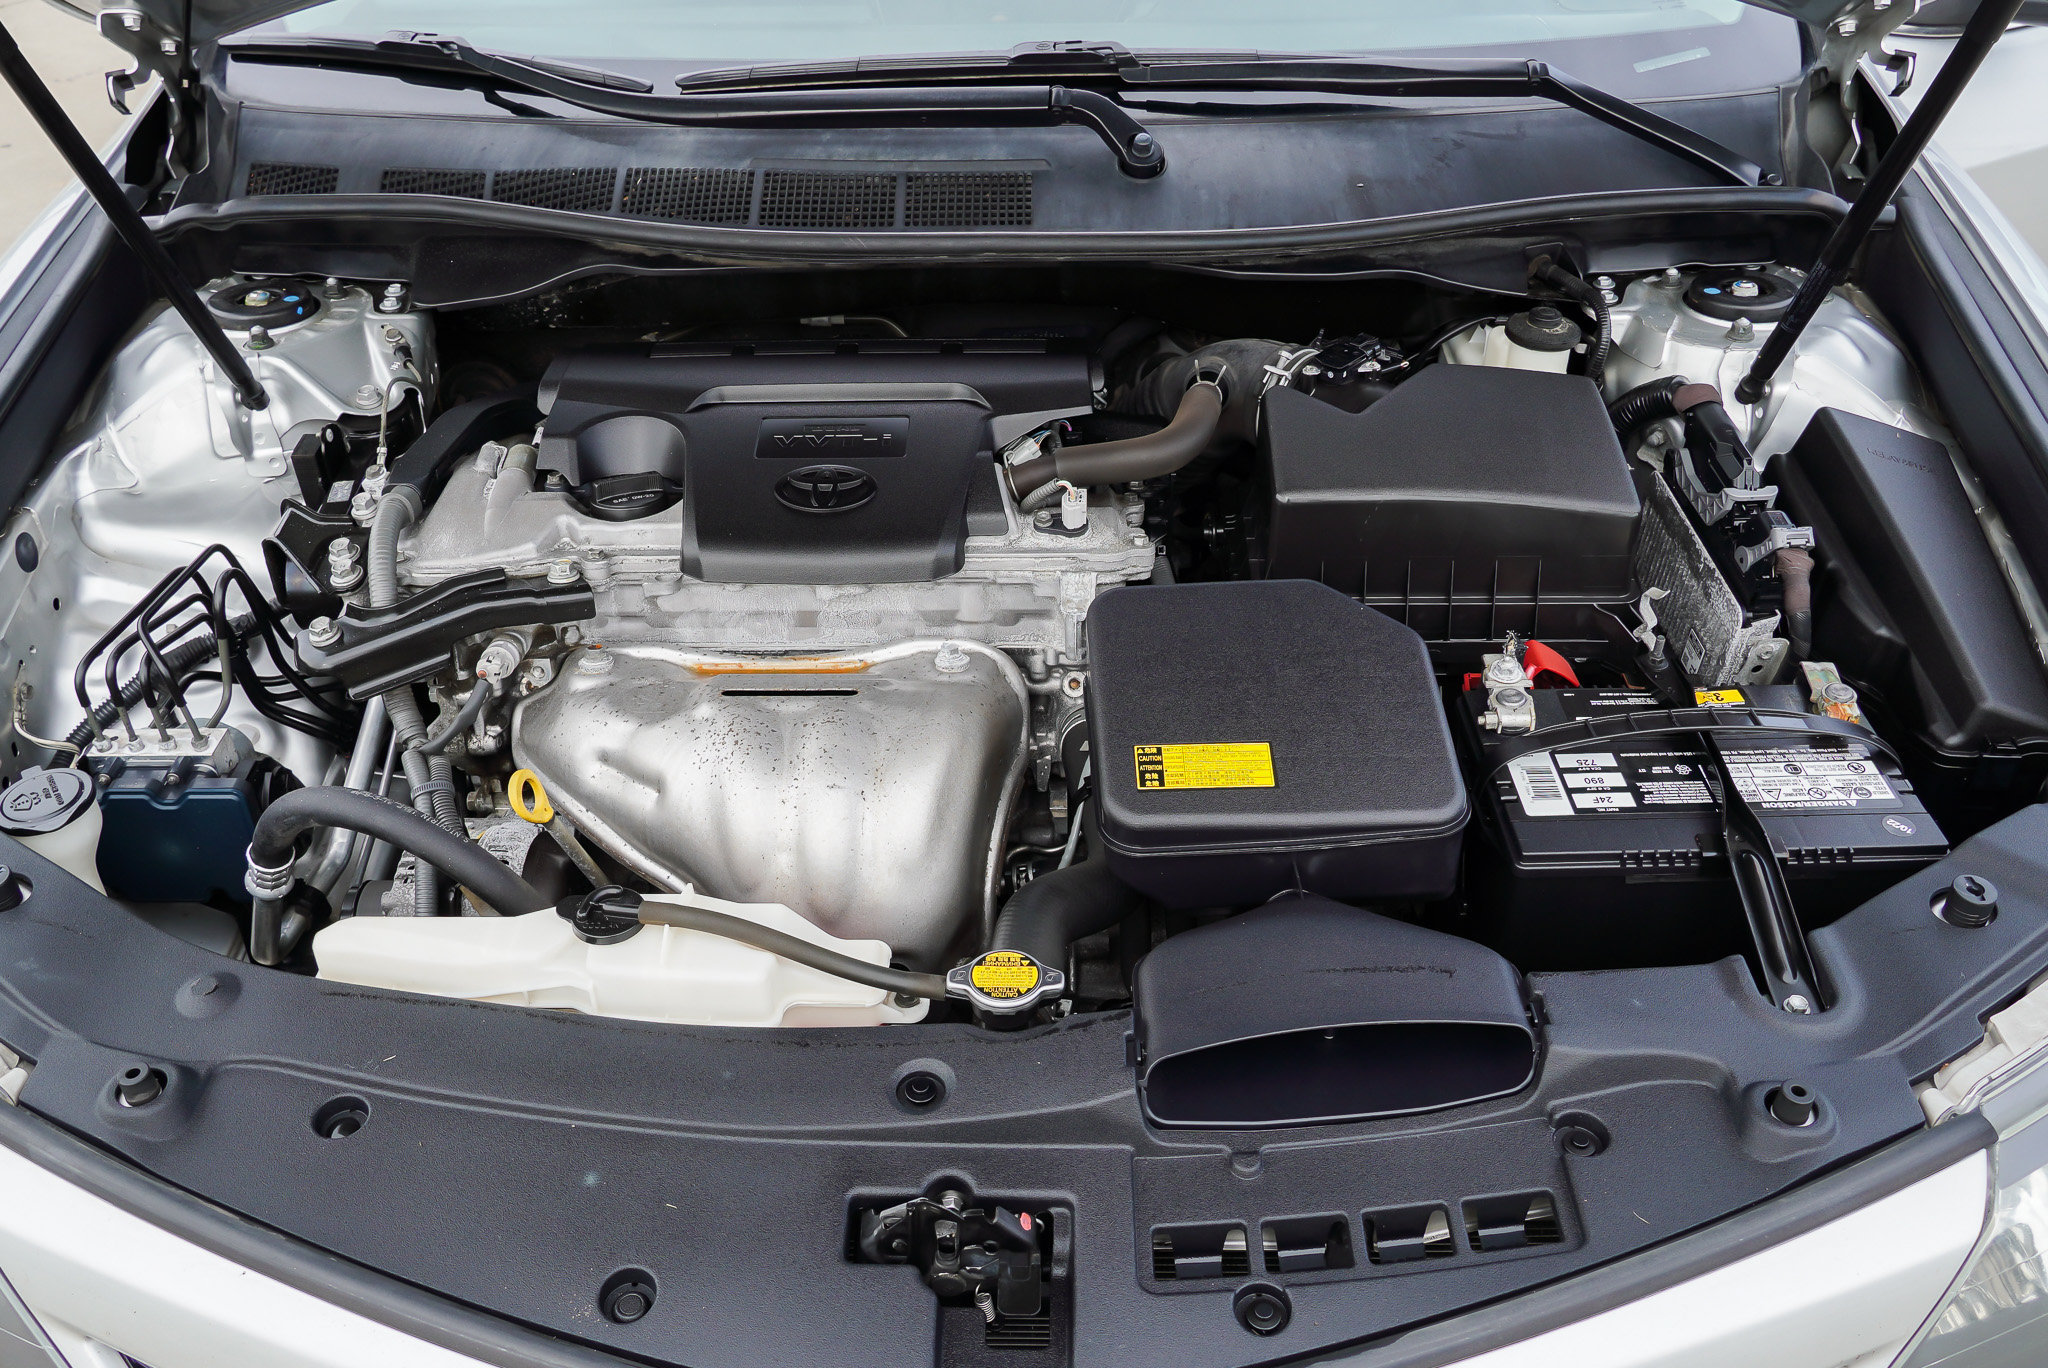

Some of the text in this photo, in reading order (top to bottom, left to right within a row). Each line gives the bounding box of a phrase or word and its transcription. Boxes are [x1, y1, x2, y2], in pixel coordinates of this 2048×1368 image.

[1713, 693, 1724, 702] 3
[1584, 777, 1605, 785] 890
[1593, 796, 1614, 804] 24F
[1761, 799, 1849, 808] DANGER/POISON
[1887, 818, 1914, 835] 10/22
